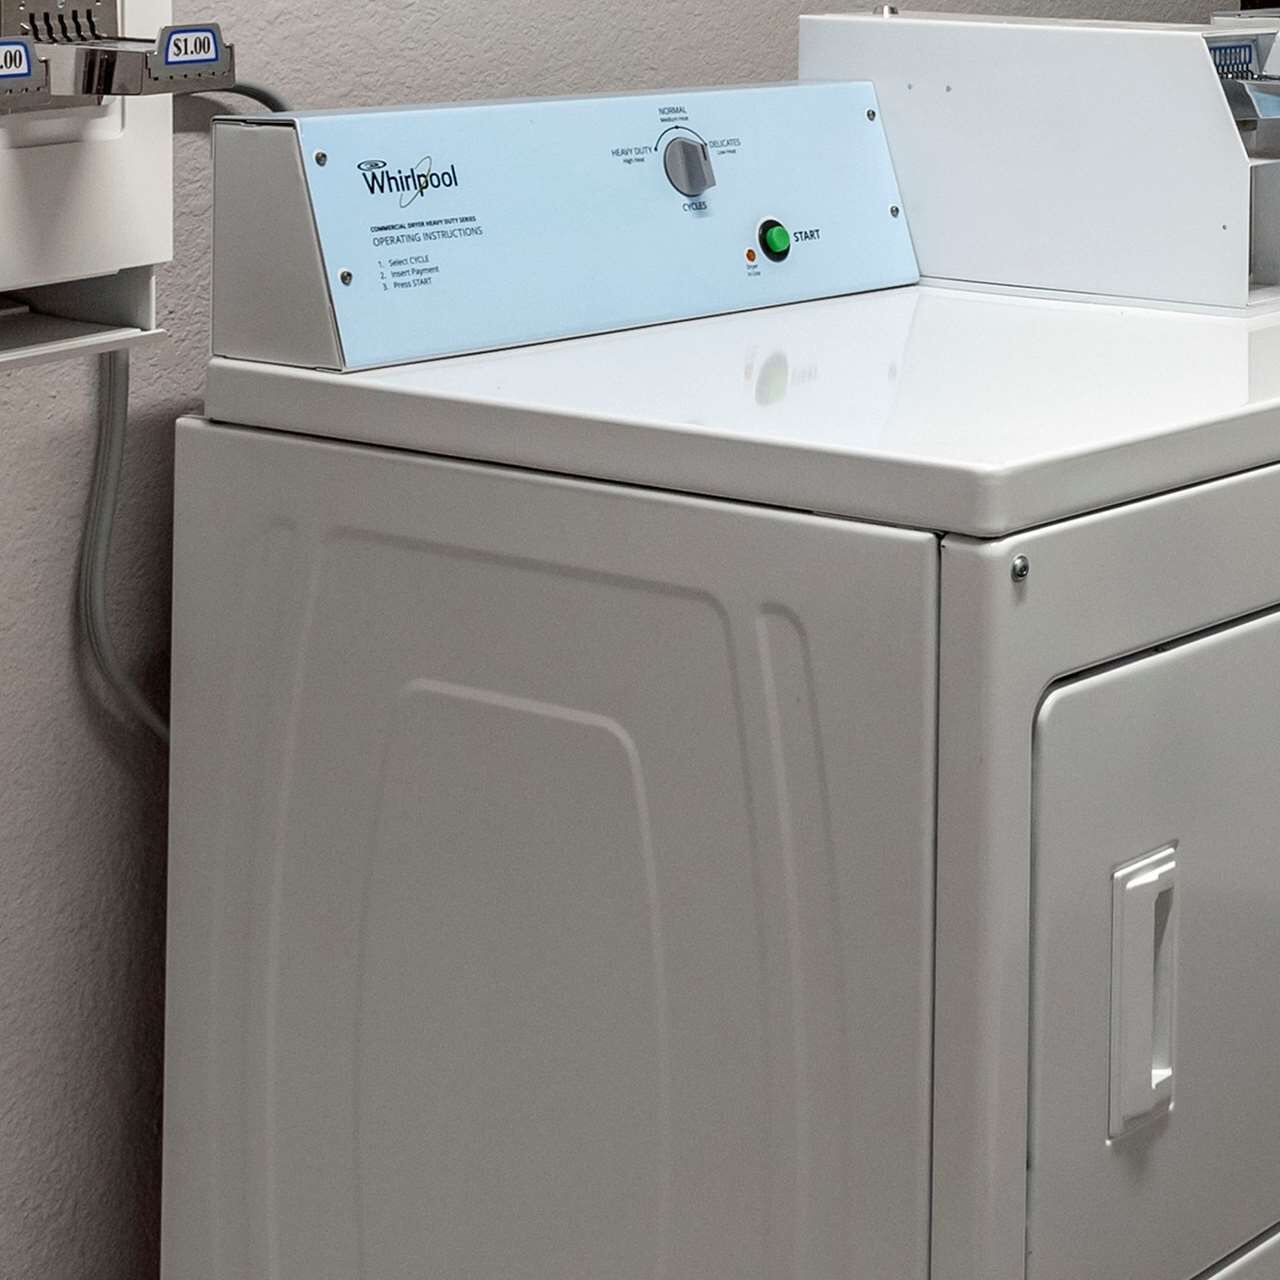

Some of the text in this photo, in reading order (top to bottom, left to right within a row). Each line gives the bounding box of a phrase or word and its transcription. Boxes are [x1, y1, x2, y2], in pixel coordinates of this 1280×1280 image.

[173, 36, 211, 57] $1.00
[658, 106, 687, 115] NORMAL
[709, 138, 741, 148] DELICATES
[611, 146, 652, 157] HEAVY DUTY
[362, 163, 458, 197] Whirlpool
[682, 201, 708, 212] CYCLES
[444, 217, 458, 225] DUTY
[373, 226, 483, 247] OPERATING INSTRUCTIONS
[793, 229, 820, 242] START
[388, 257, 408, 267] Select
[410, 255, 429, 265] CYCLE
[391, 268, 411, 278] Insert
[411, 266, 439, 277] Payment
[393, 281, 412, 289] Press
[413, 277, 432, 287] START
